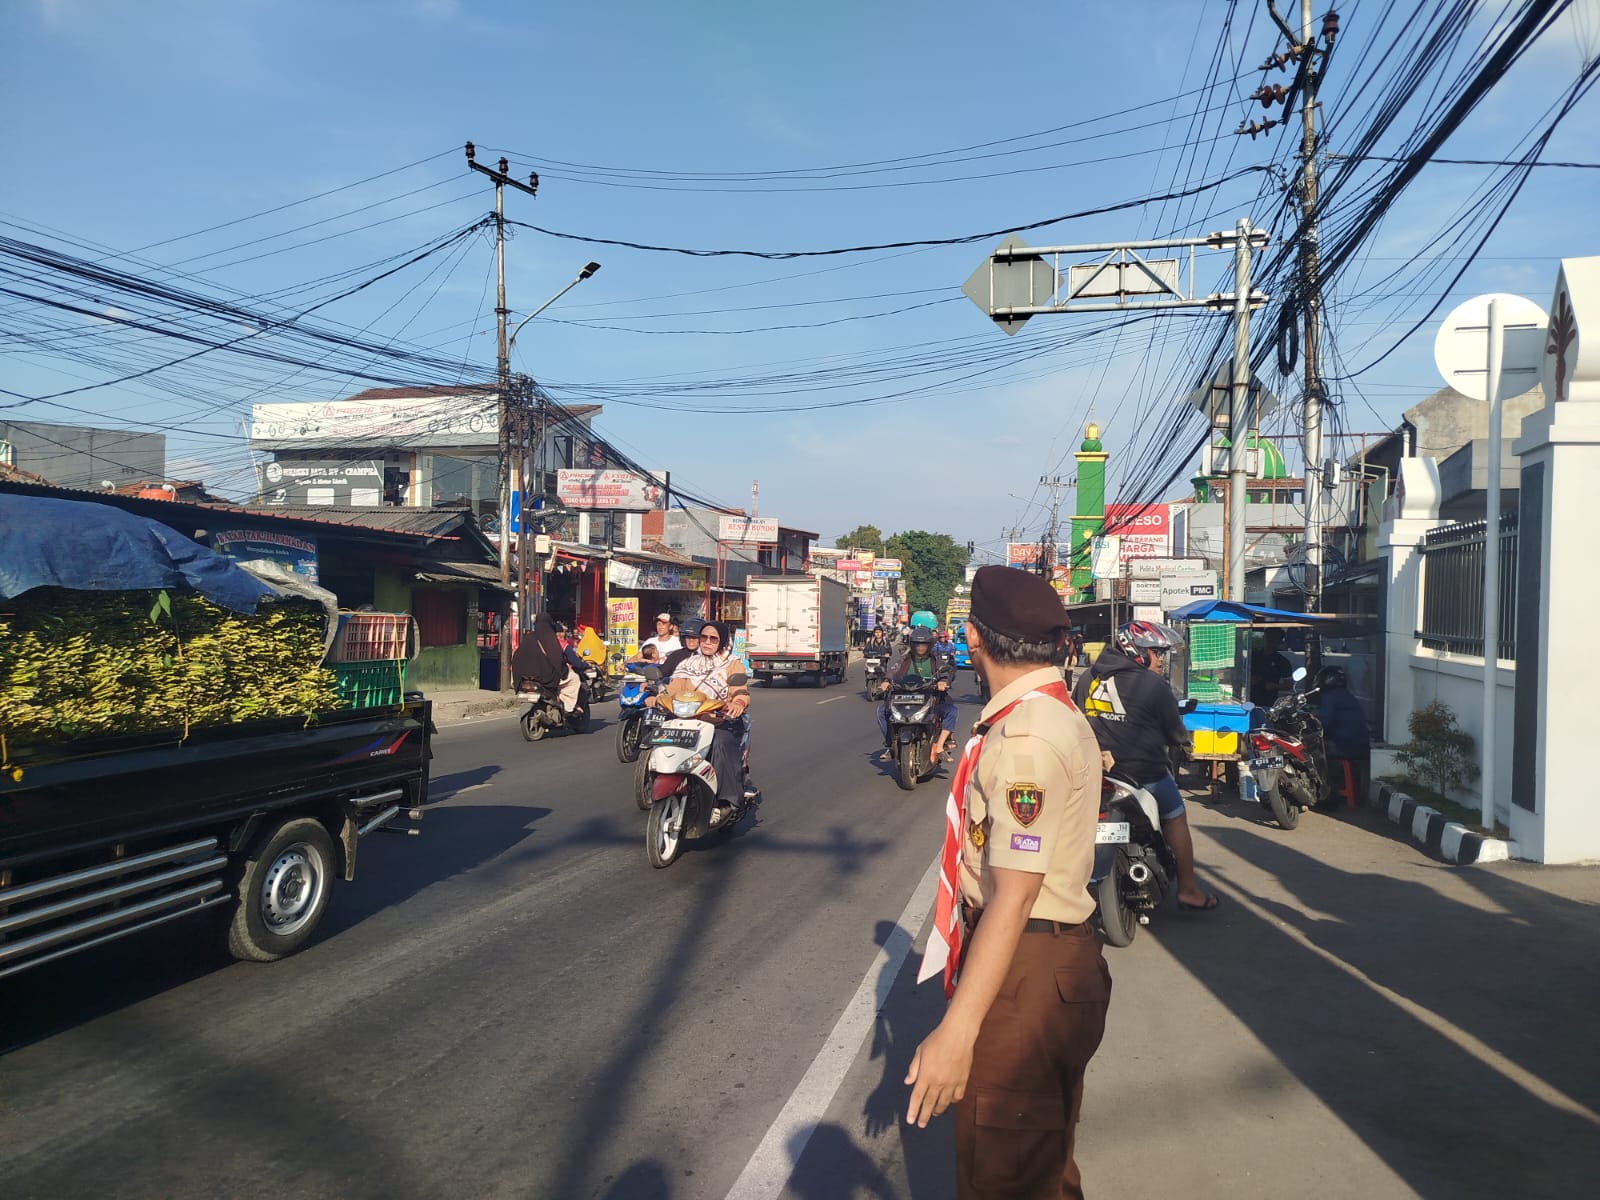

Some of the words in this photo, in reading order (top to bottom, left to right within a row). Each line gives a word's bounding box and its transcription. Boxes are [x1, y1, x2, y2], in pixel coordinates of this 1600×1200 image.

[1094, 540, 1110, 549] BSI
[1120, 544, 1156, 553] HARGA
[1162, 587, 1190, 596] Apotek
[1192, 586, 1213, 595] PMC
[611, 612, 635, 623] SERVICE
